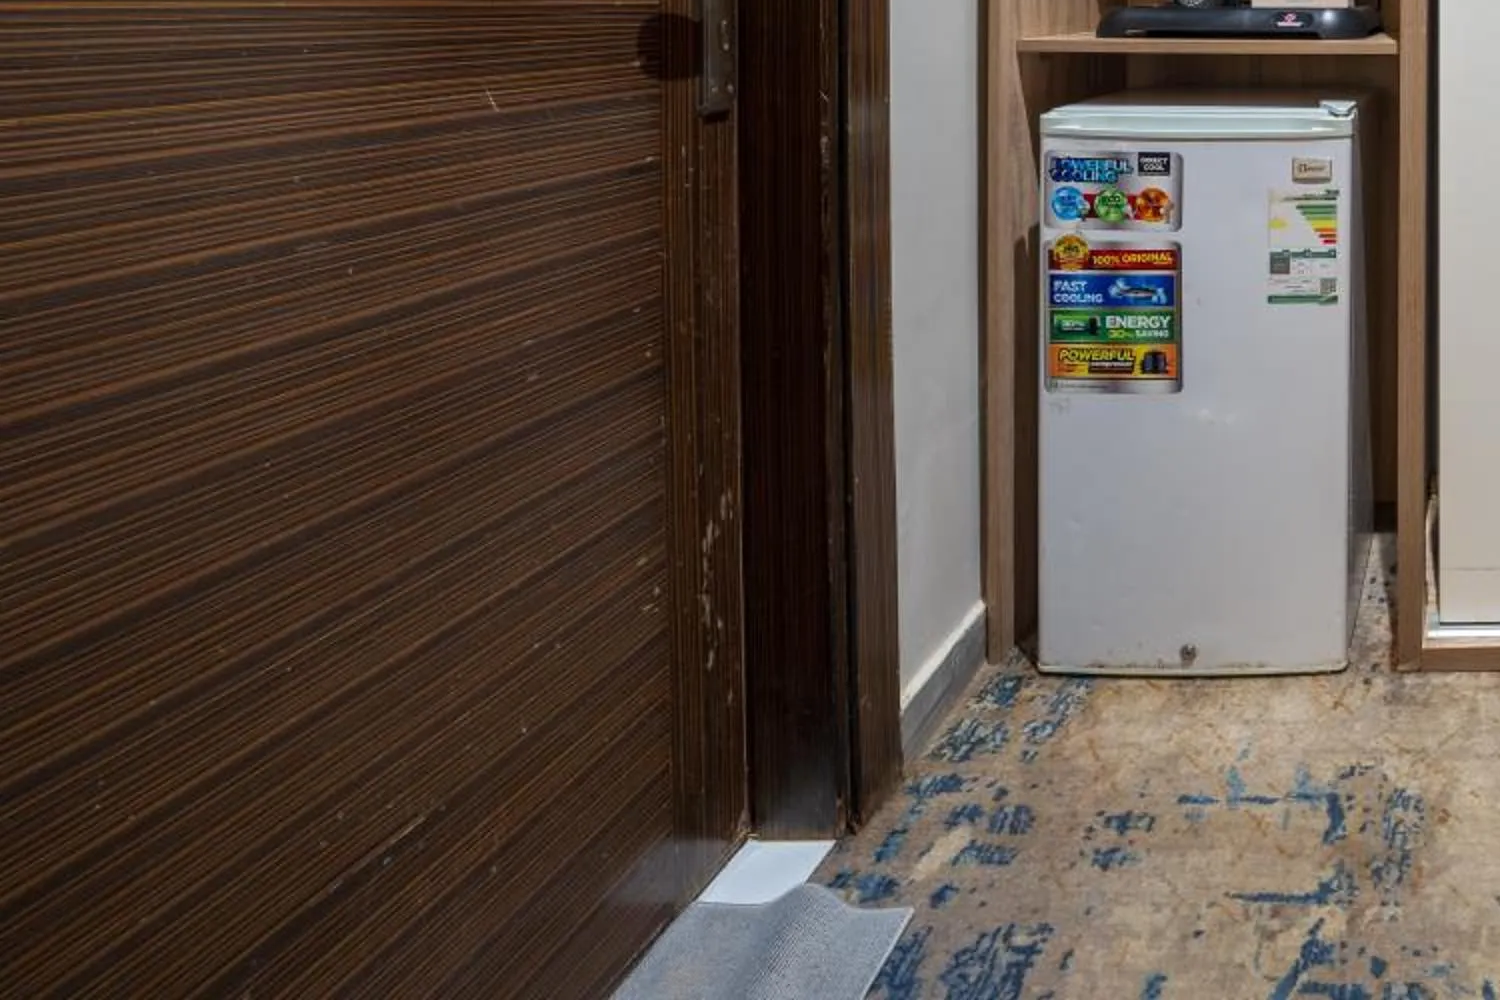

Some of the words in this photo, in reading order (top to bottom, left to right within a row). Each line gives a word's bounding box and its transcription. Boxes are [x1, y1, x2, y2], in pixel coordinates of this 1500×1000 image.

[1053, 280, 1088, 292] FAST
[1053, 293, 1104, 303] COOLING
[1105, 315, 1171, 328] ENERGY
[1057, 347, 1137, 361] POWERFUL
